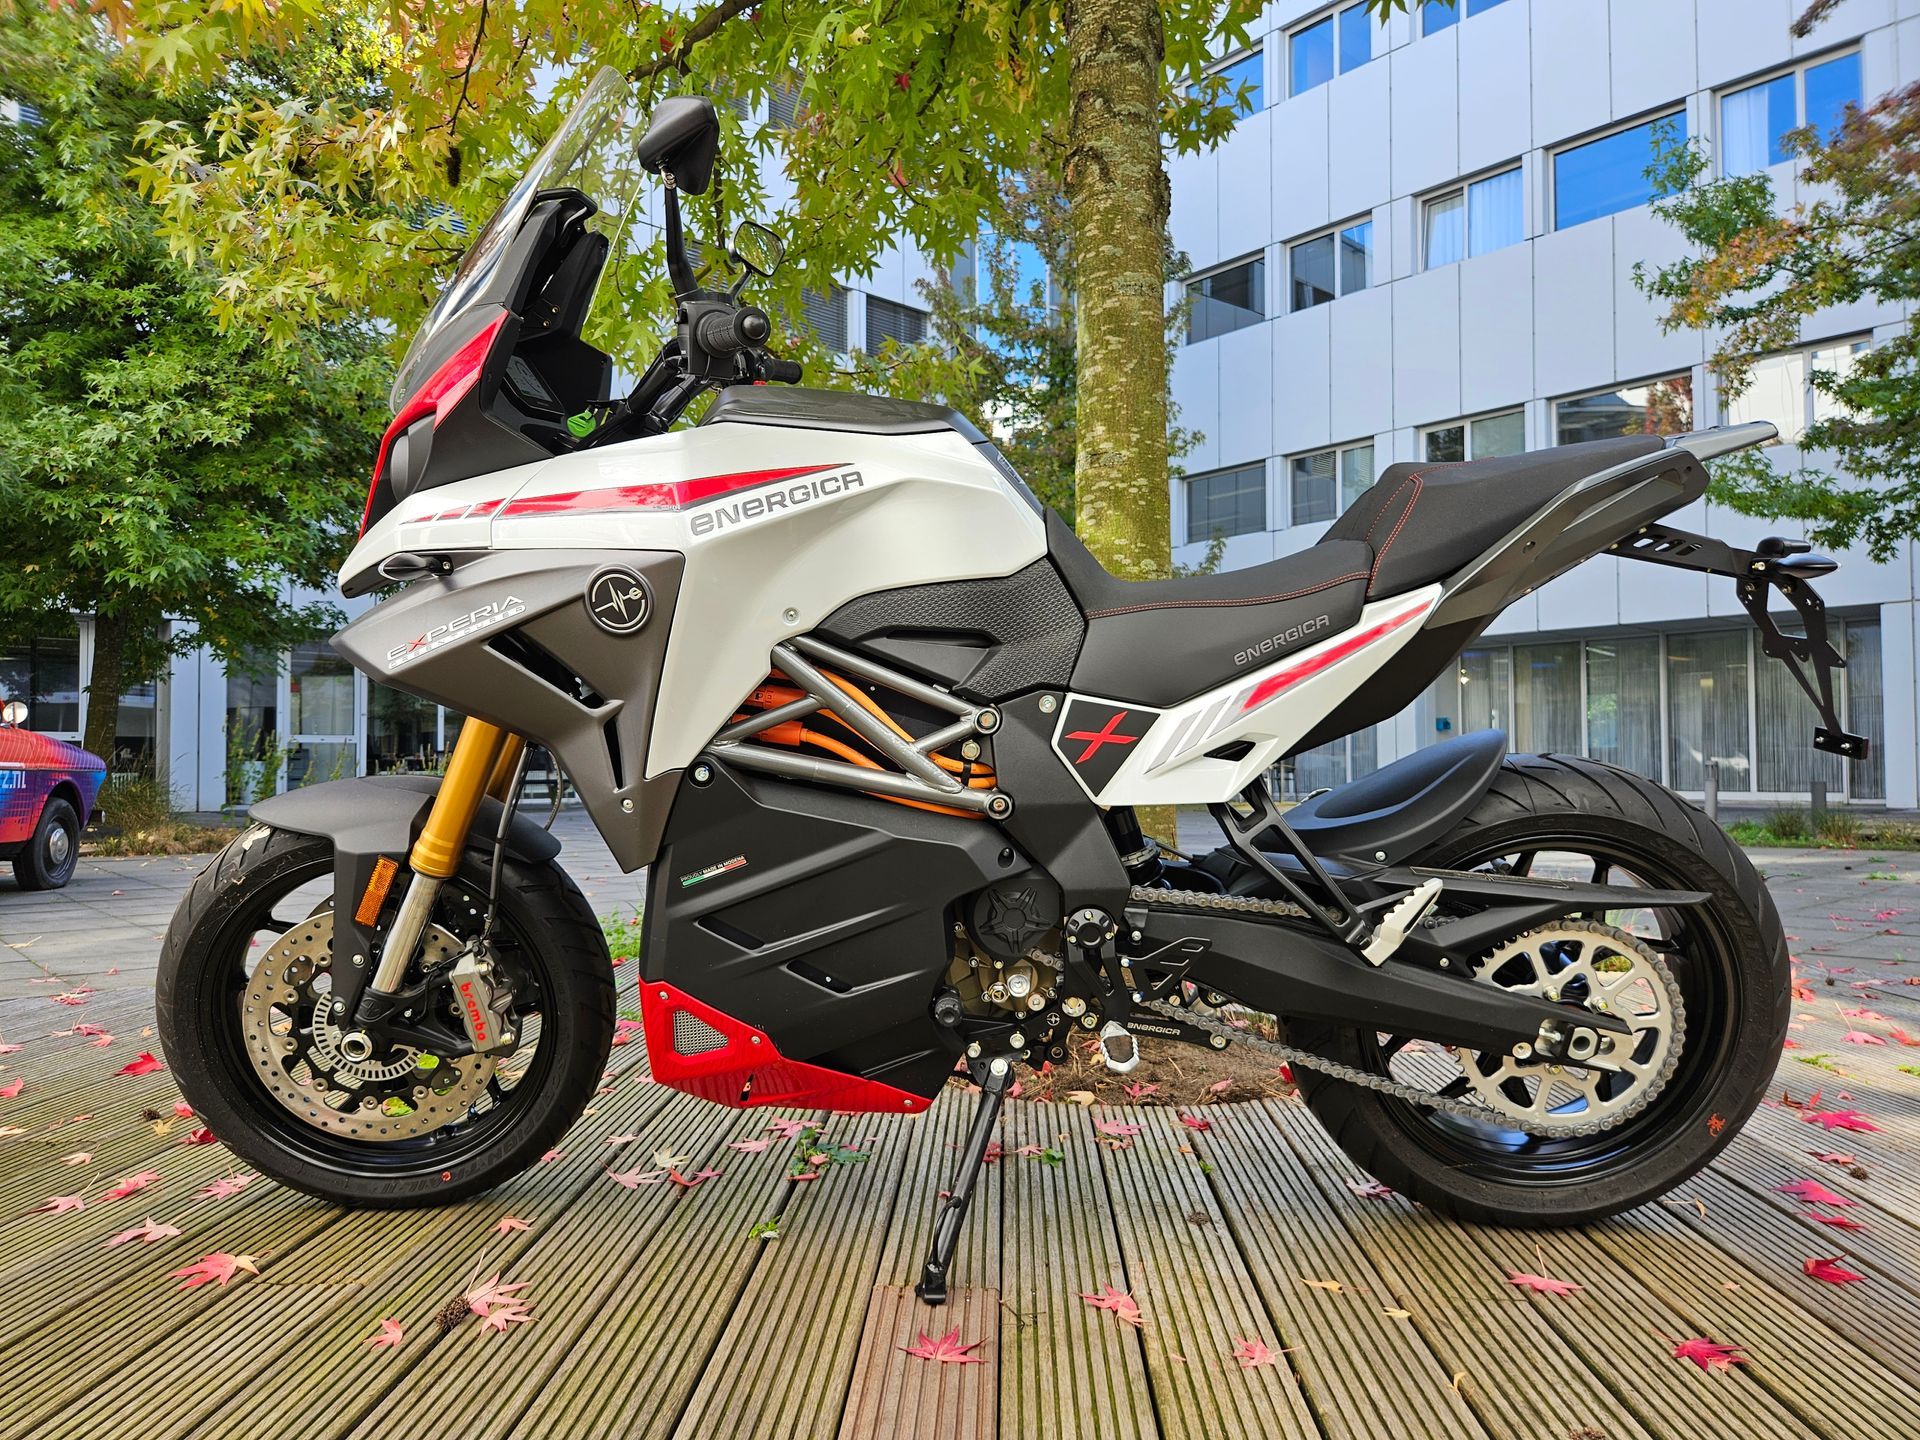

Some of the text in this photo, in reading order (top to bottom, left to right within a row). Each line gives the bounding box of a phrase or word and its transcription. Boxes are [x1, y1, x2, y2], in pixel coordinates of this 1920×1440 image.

[690, 471, 865, 536] ENERGICA
[387, 595, 524, 661] EXPERIA
[1233, 614, 1330, 666] ENERGICA
[460, 981, 486, 1041] brembo
[1127, 1021, 1181, 1036] ENERGICA
